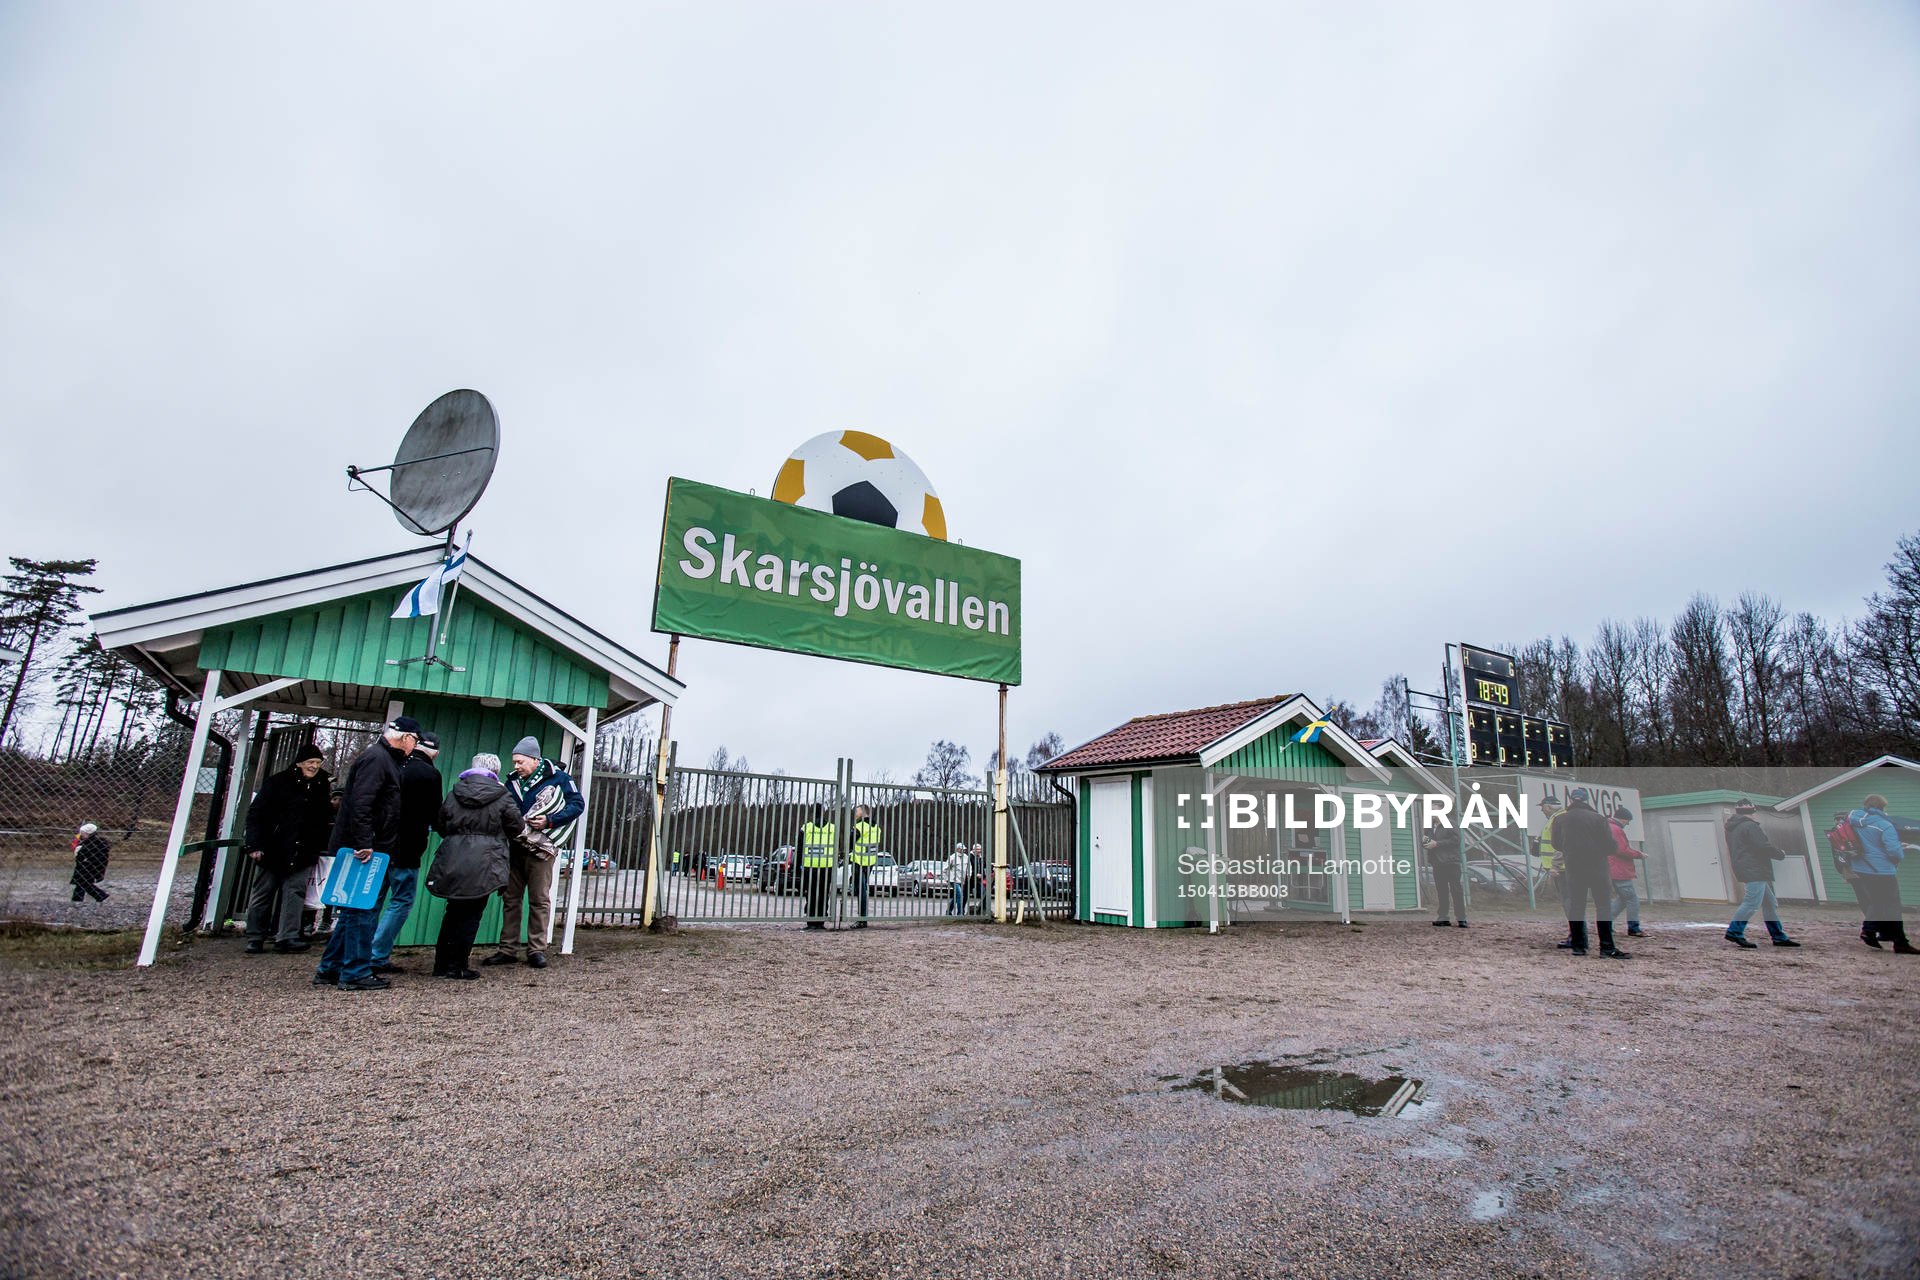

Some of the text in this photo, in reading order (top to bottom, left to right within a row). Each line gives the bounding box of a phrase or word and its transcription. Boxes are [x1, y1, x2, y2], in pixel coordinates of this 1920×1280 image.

[679, 527, 1010, 635] Skarsjövallen
[1463, 650, 1515, 677] H G
[1478, 681, 1509, 705] 18:49
[1469, 711, 1476, 728] A
[1496, 717, 1503, 732] C
[1523, 722, 1530, 738] E
[1470, 742, 1477, 758] B
[1499, 747, 1506, 762] D
[1525, 751, 1532, 768] F
